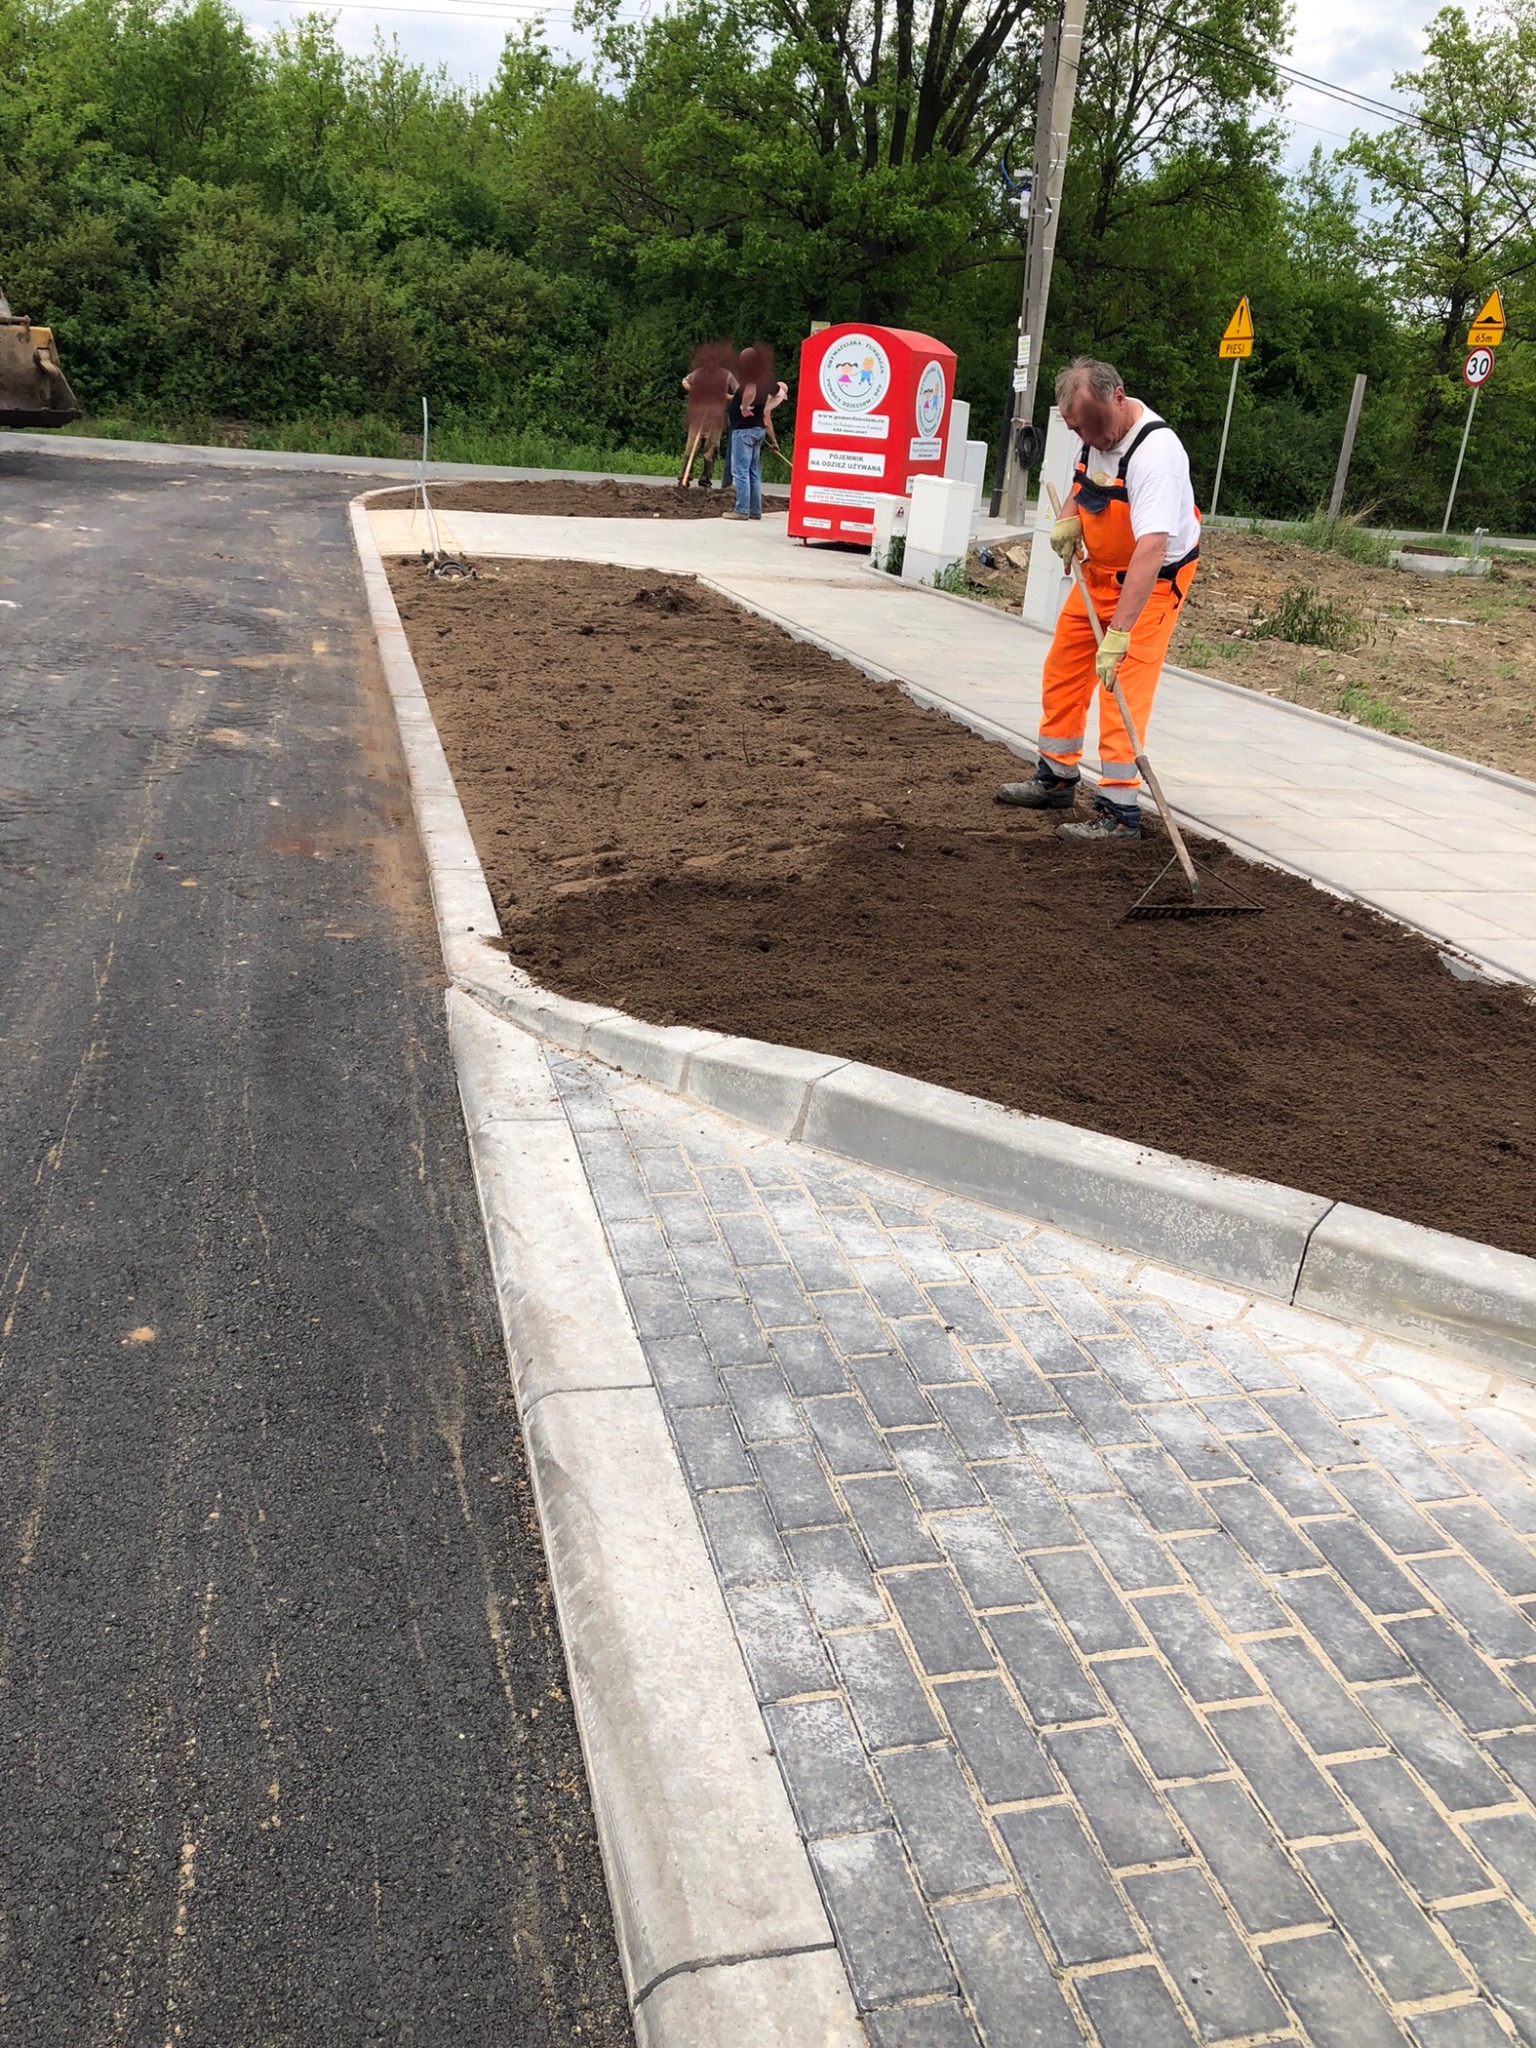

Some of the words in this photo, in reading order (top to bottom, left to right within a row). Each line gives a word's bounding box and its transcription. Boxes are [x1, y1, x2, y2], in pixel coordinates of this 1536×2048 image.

[1475, 333, 1493, 343] 65m
[1226, 344, 1245, 354] PIESI
[827, 340, 862, 369] OBYWATELSKA
[865, 343, 885, 374] FUNDACJA
[1468, 357, 1489, 375] 30
[826, 378, 842, 403] POMOCY
[842, 398, 872, 409] DZIECIOM
[829, 453, 864, 462] POJEMNIK
[822, 460, 846, 469] ODZIEŻ
[848, 462, 881, 473] UŻYWANĄ
